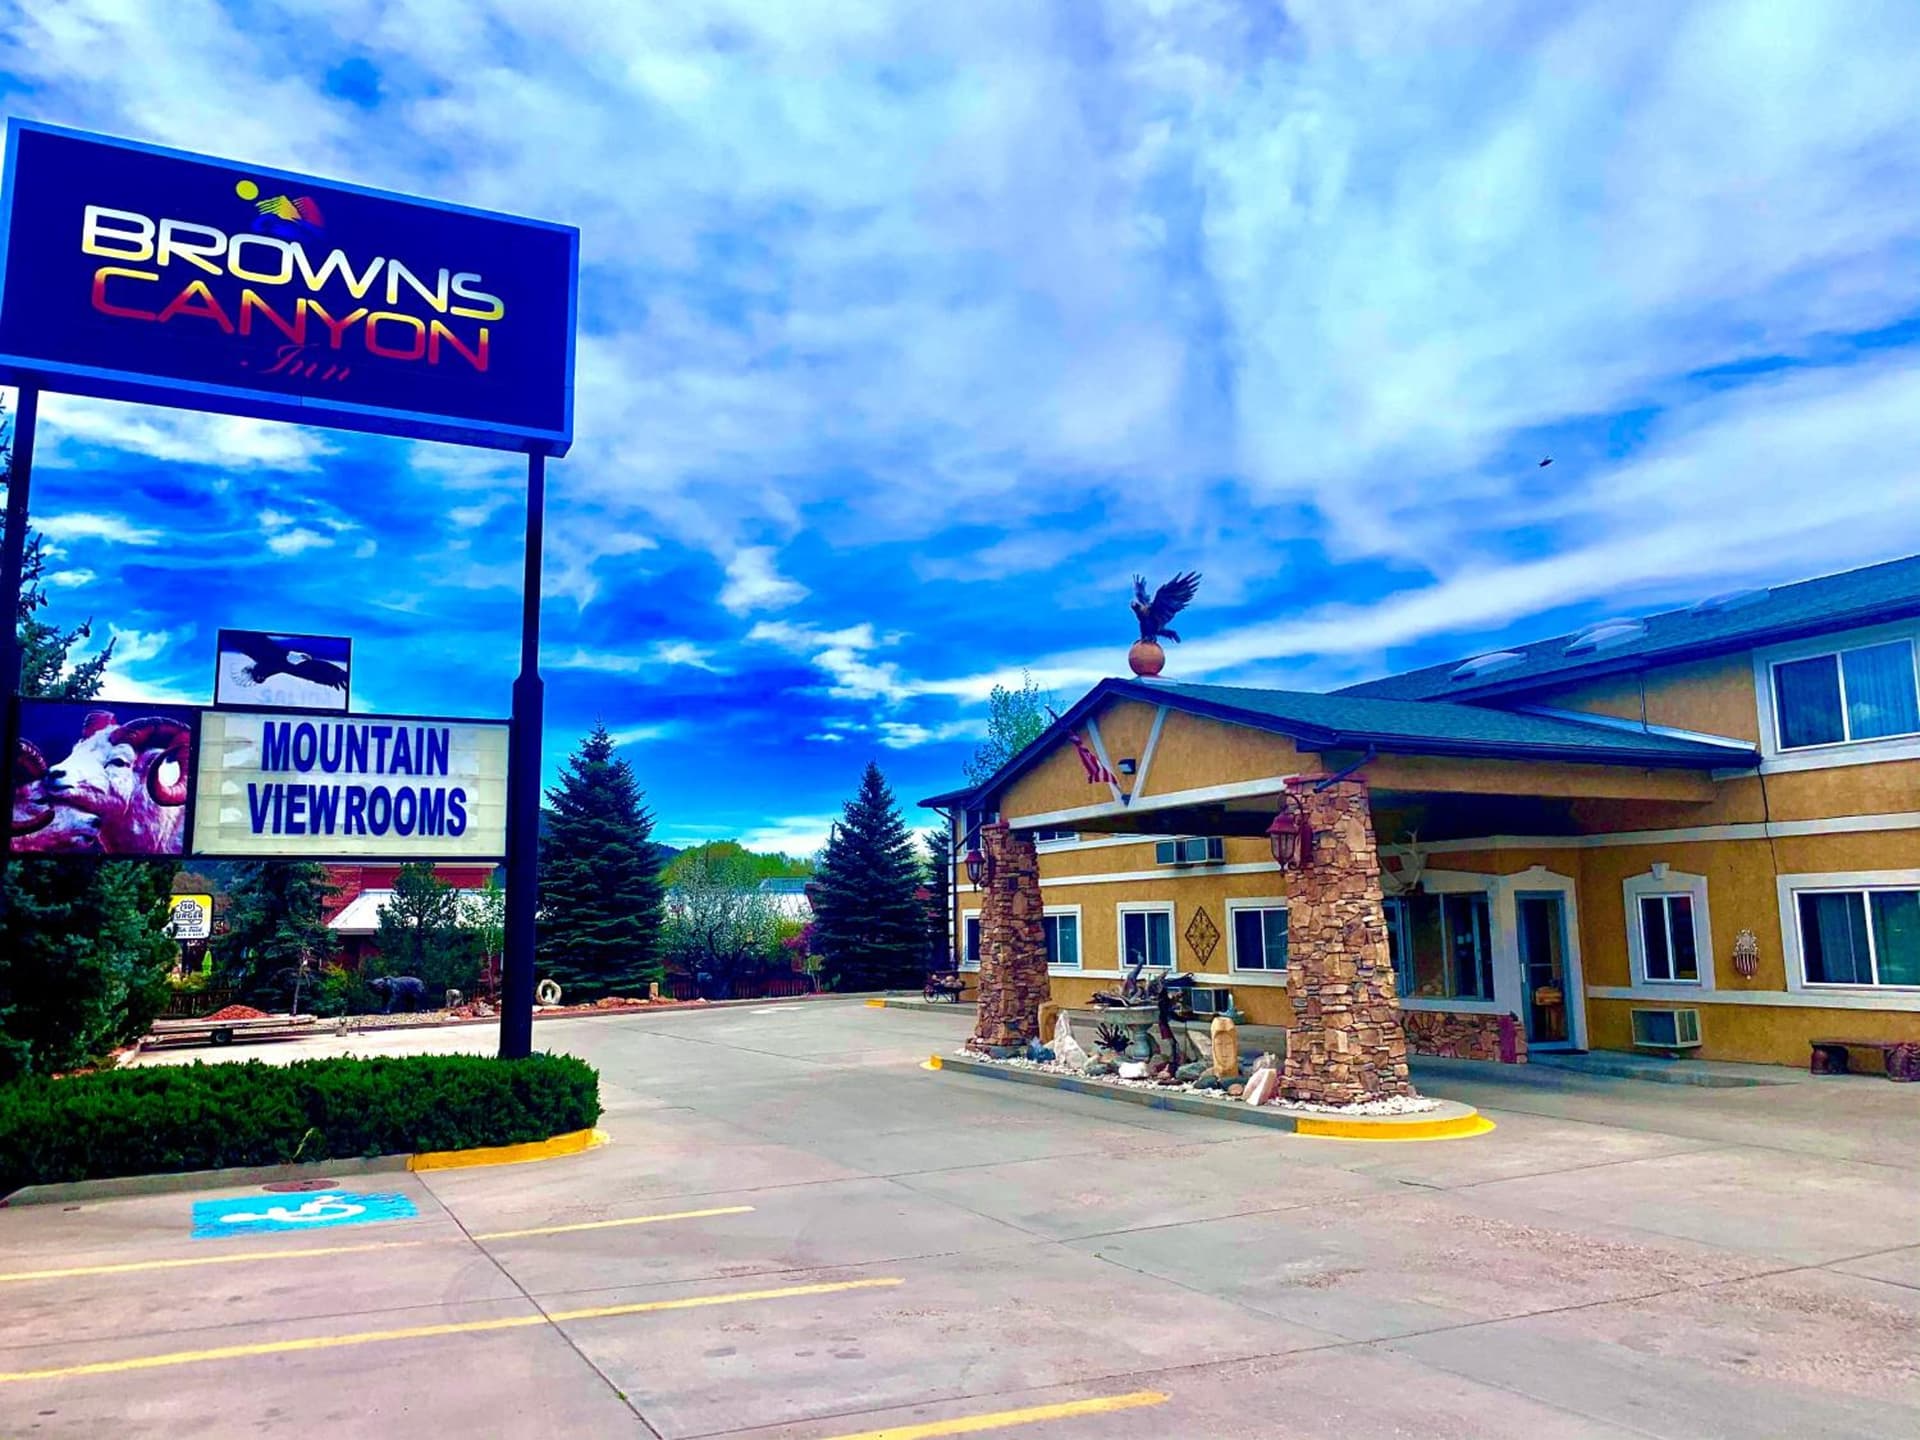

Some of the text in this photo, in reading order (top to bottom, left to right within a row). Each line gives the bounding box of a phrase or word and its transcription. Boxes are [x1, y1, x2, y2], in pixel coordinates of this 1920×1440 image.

[81, 204, 505, 320] BROWNS
[91, 266, 489, 372] CANYON
[257, 344, 350, 381] Inn
[261, 721, 450, 775] MOUNTAIN
